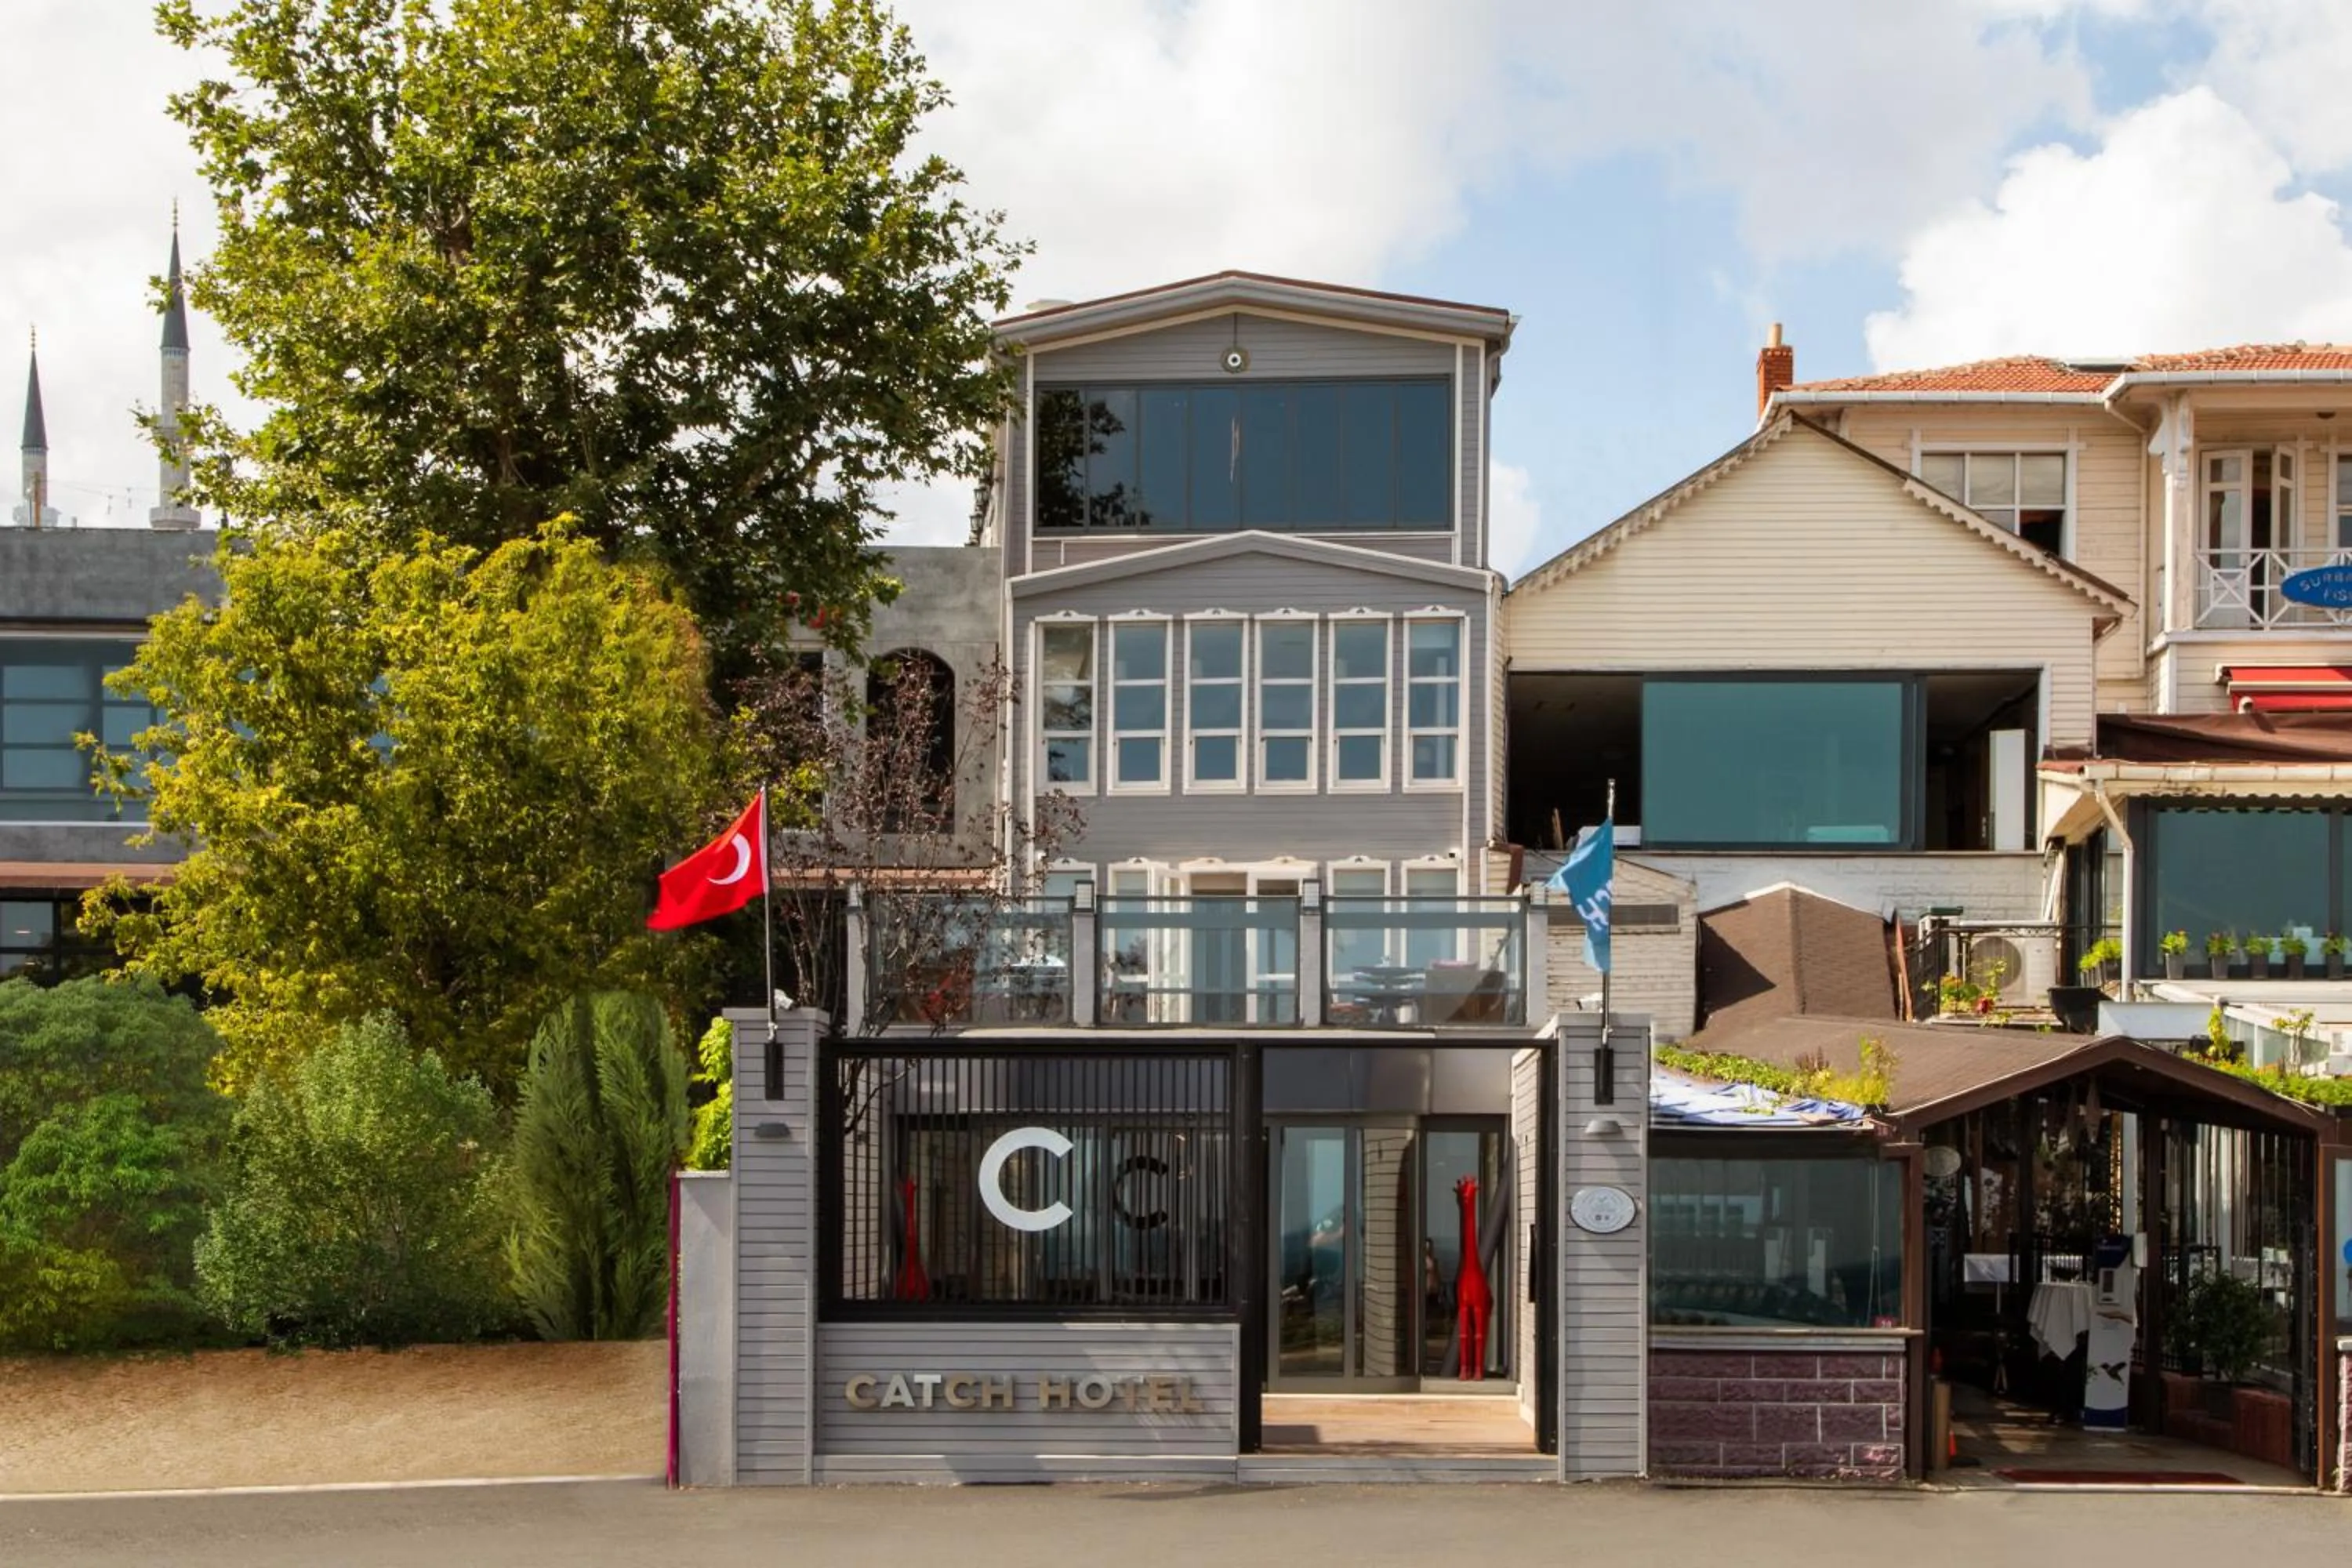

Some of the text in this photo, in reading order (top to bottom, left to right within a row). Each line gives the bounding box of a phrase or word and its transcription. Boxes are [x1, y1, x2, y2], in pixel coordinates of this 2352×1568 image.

[979, 1127, 1073, 1231] C
[845, 1374, 1203, 1410] CATCH HOTEL
